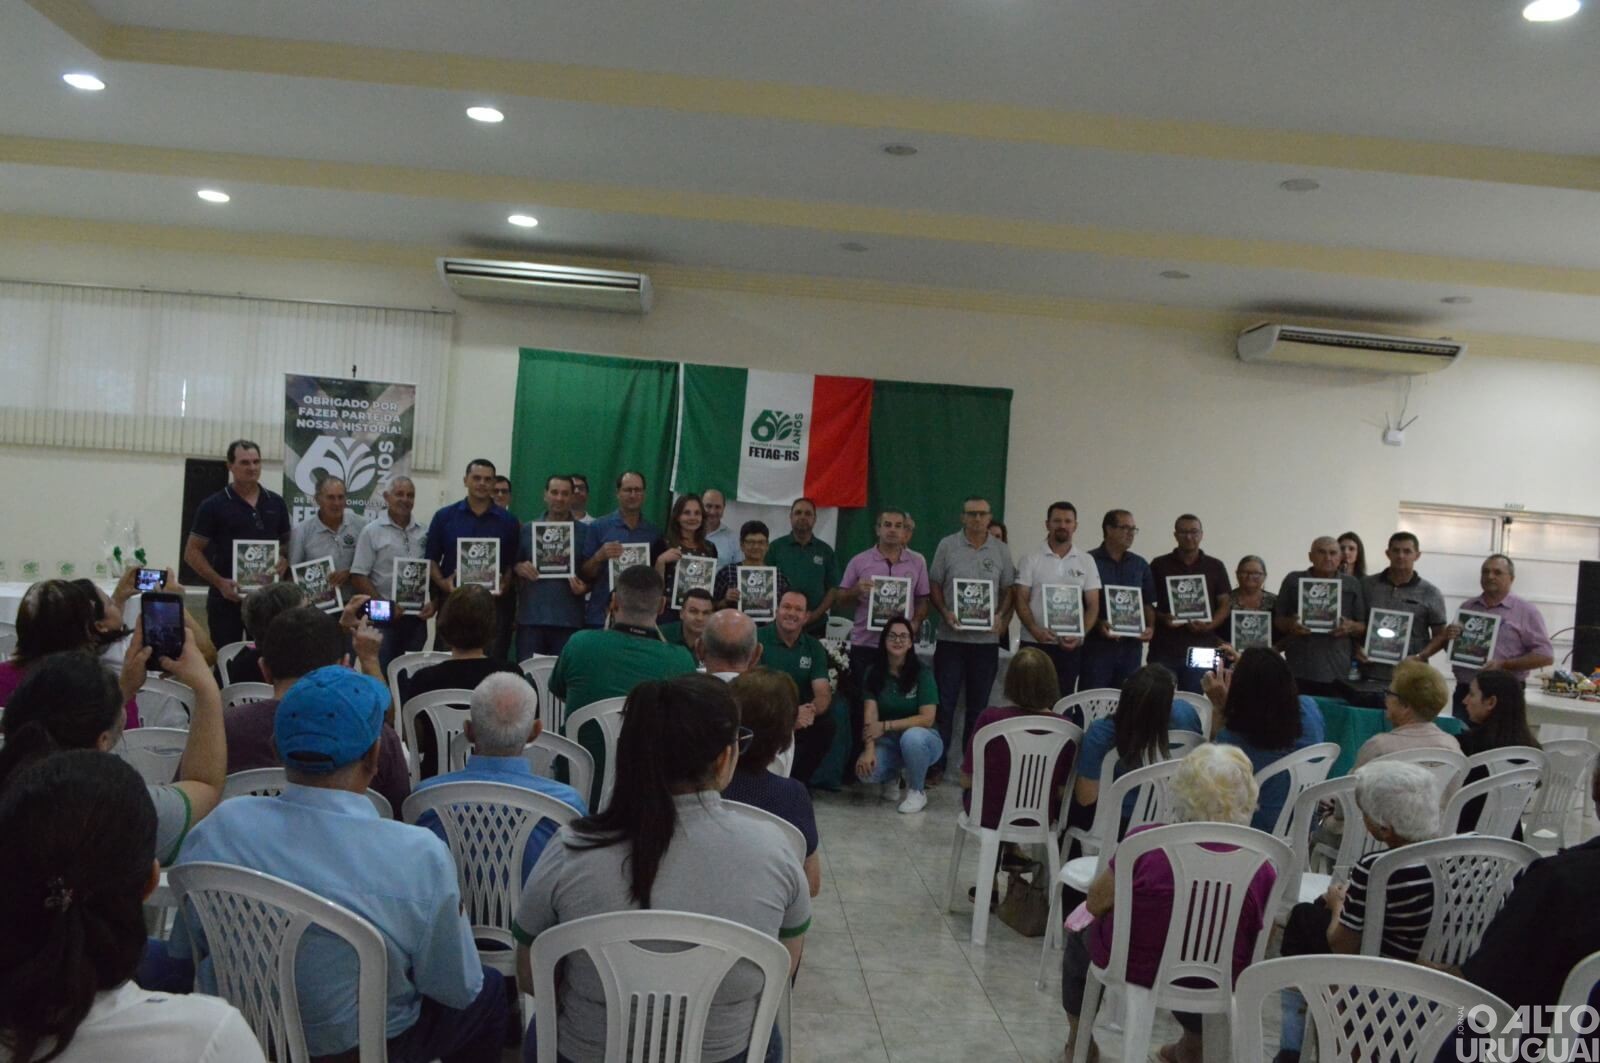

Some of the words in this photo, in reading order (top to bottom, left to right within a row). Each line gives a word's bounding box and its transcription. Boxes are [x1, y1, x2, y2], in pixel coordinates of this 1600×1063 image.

[303, 395, 369, 409] OBRIGADO
[372, 401, 398, 411] POR
[298, 406, 338, 418] FAZER
[341, 410, 381, 422] PARTE
[384, 414, 401, 423] DA
[296, 418, 339, 430] NOSSA
[792, 413, 803, 445] ANOS
[749, 446, 799, 461] FETAG-RS
